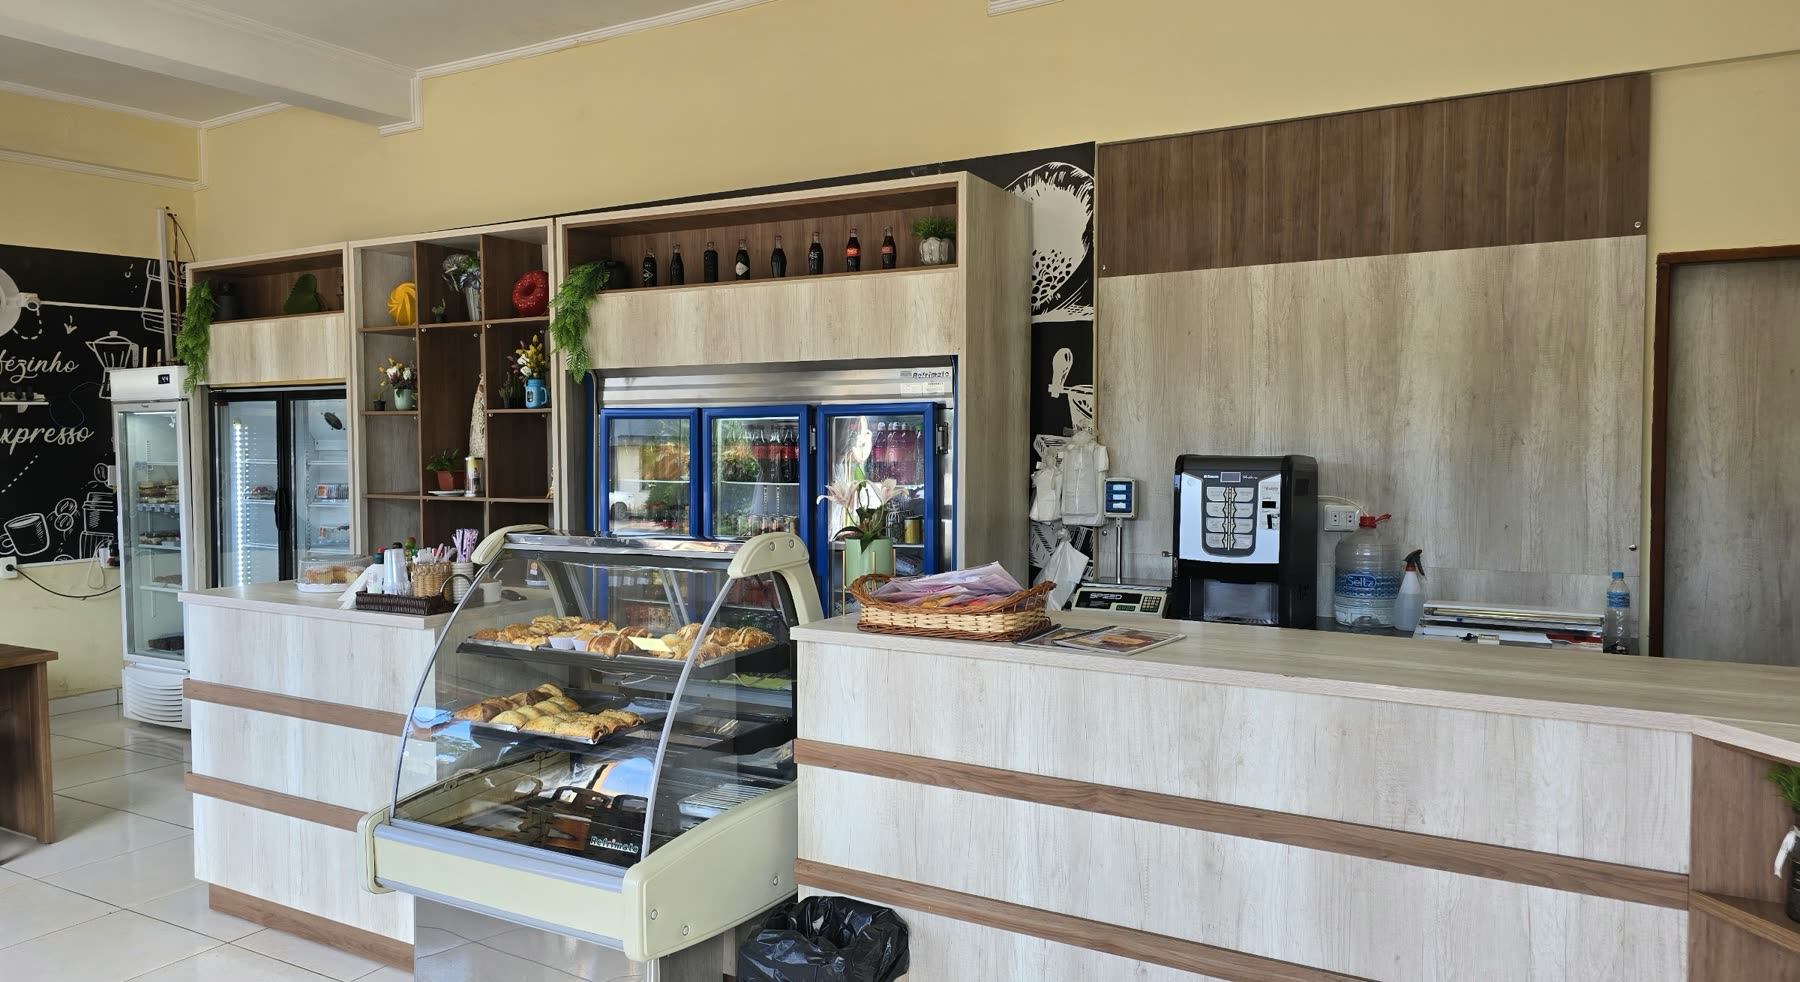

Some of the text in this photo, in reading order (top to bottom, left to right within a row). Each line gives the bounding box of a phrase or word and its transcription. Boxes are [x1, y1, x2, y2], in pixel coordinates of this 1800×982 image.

[0, 427, 94, 455] xpresso
[1347, 576, 1373, 588] Seltz
[1090, 592, 1122, 600] SPEED
[590, 835, 639, 854] Refrimate
